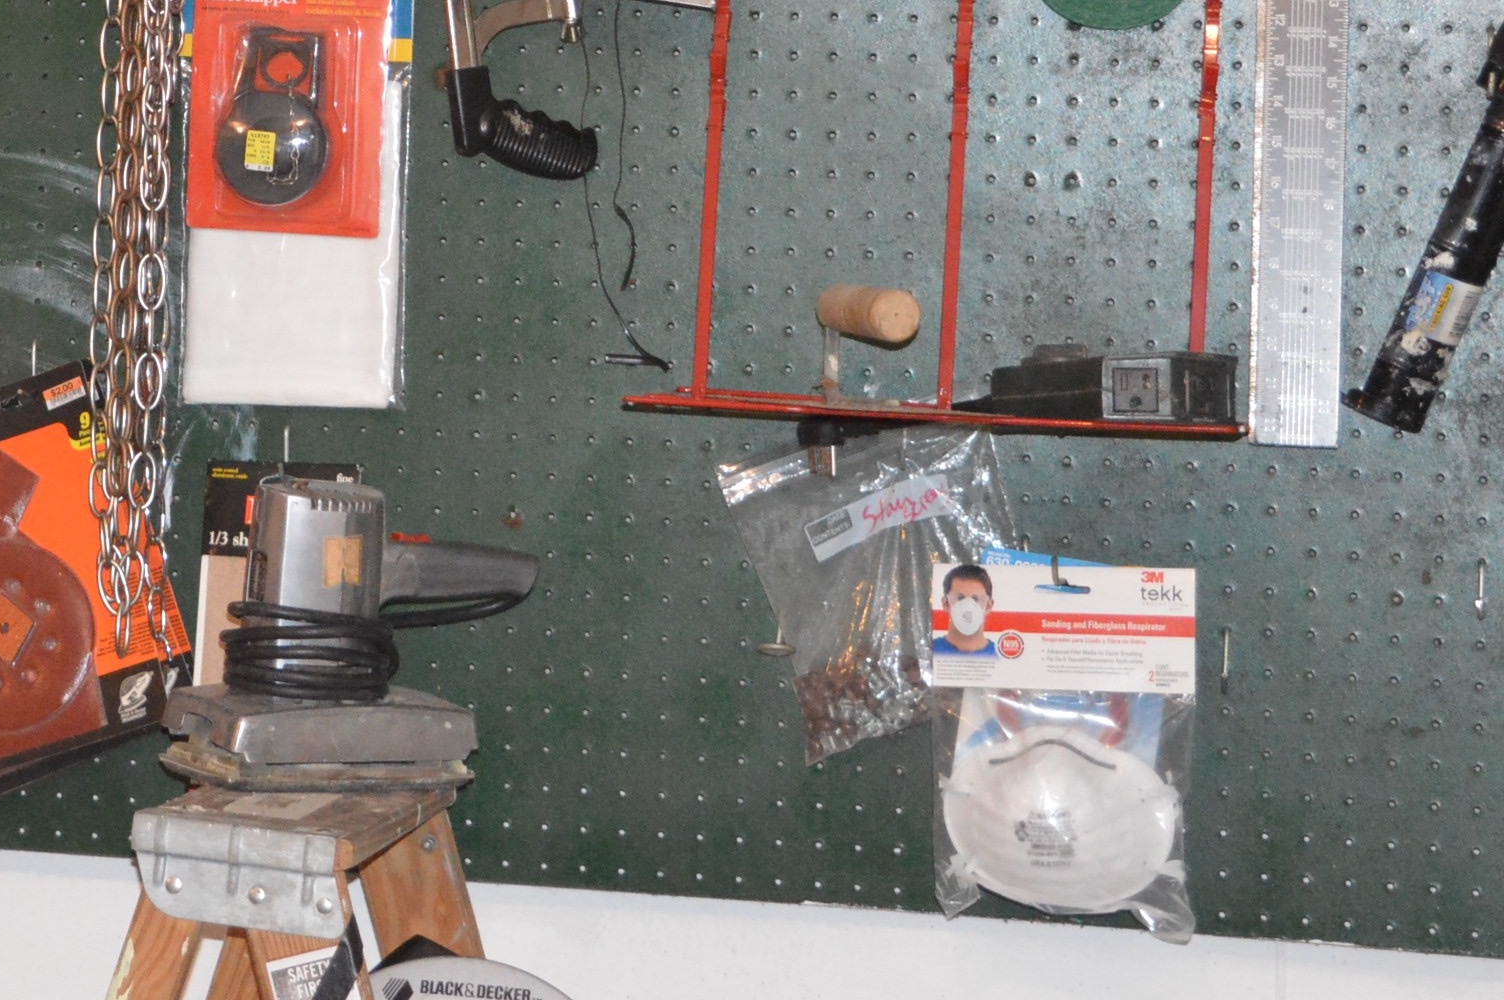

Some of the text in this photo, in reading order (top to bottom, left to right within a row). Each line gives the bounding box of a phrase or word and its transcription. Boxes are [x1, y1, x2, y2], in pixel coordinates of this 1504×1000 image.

[1327, 36, 1338, 48] 14
[1326, 77, 1337, 89] 15
[1325, 117, 1336, 130] 16
[50, 382, 74, 397] $2.00
[80, 411, 90, 429] 9
[208, 531, 228, 545] 1/3
[812, 521, 852, 544] CONTENTS
[1141, 571, 1164, 583] 3M
[1140, 585, 1183, 601] tekk
[1041, 619, 1166, 632] Sanding and Fiberglass Respirator
[1148, 671, 1155, 682] 2
[420, 979, 531, 1000] BLACK&DECKER
